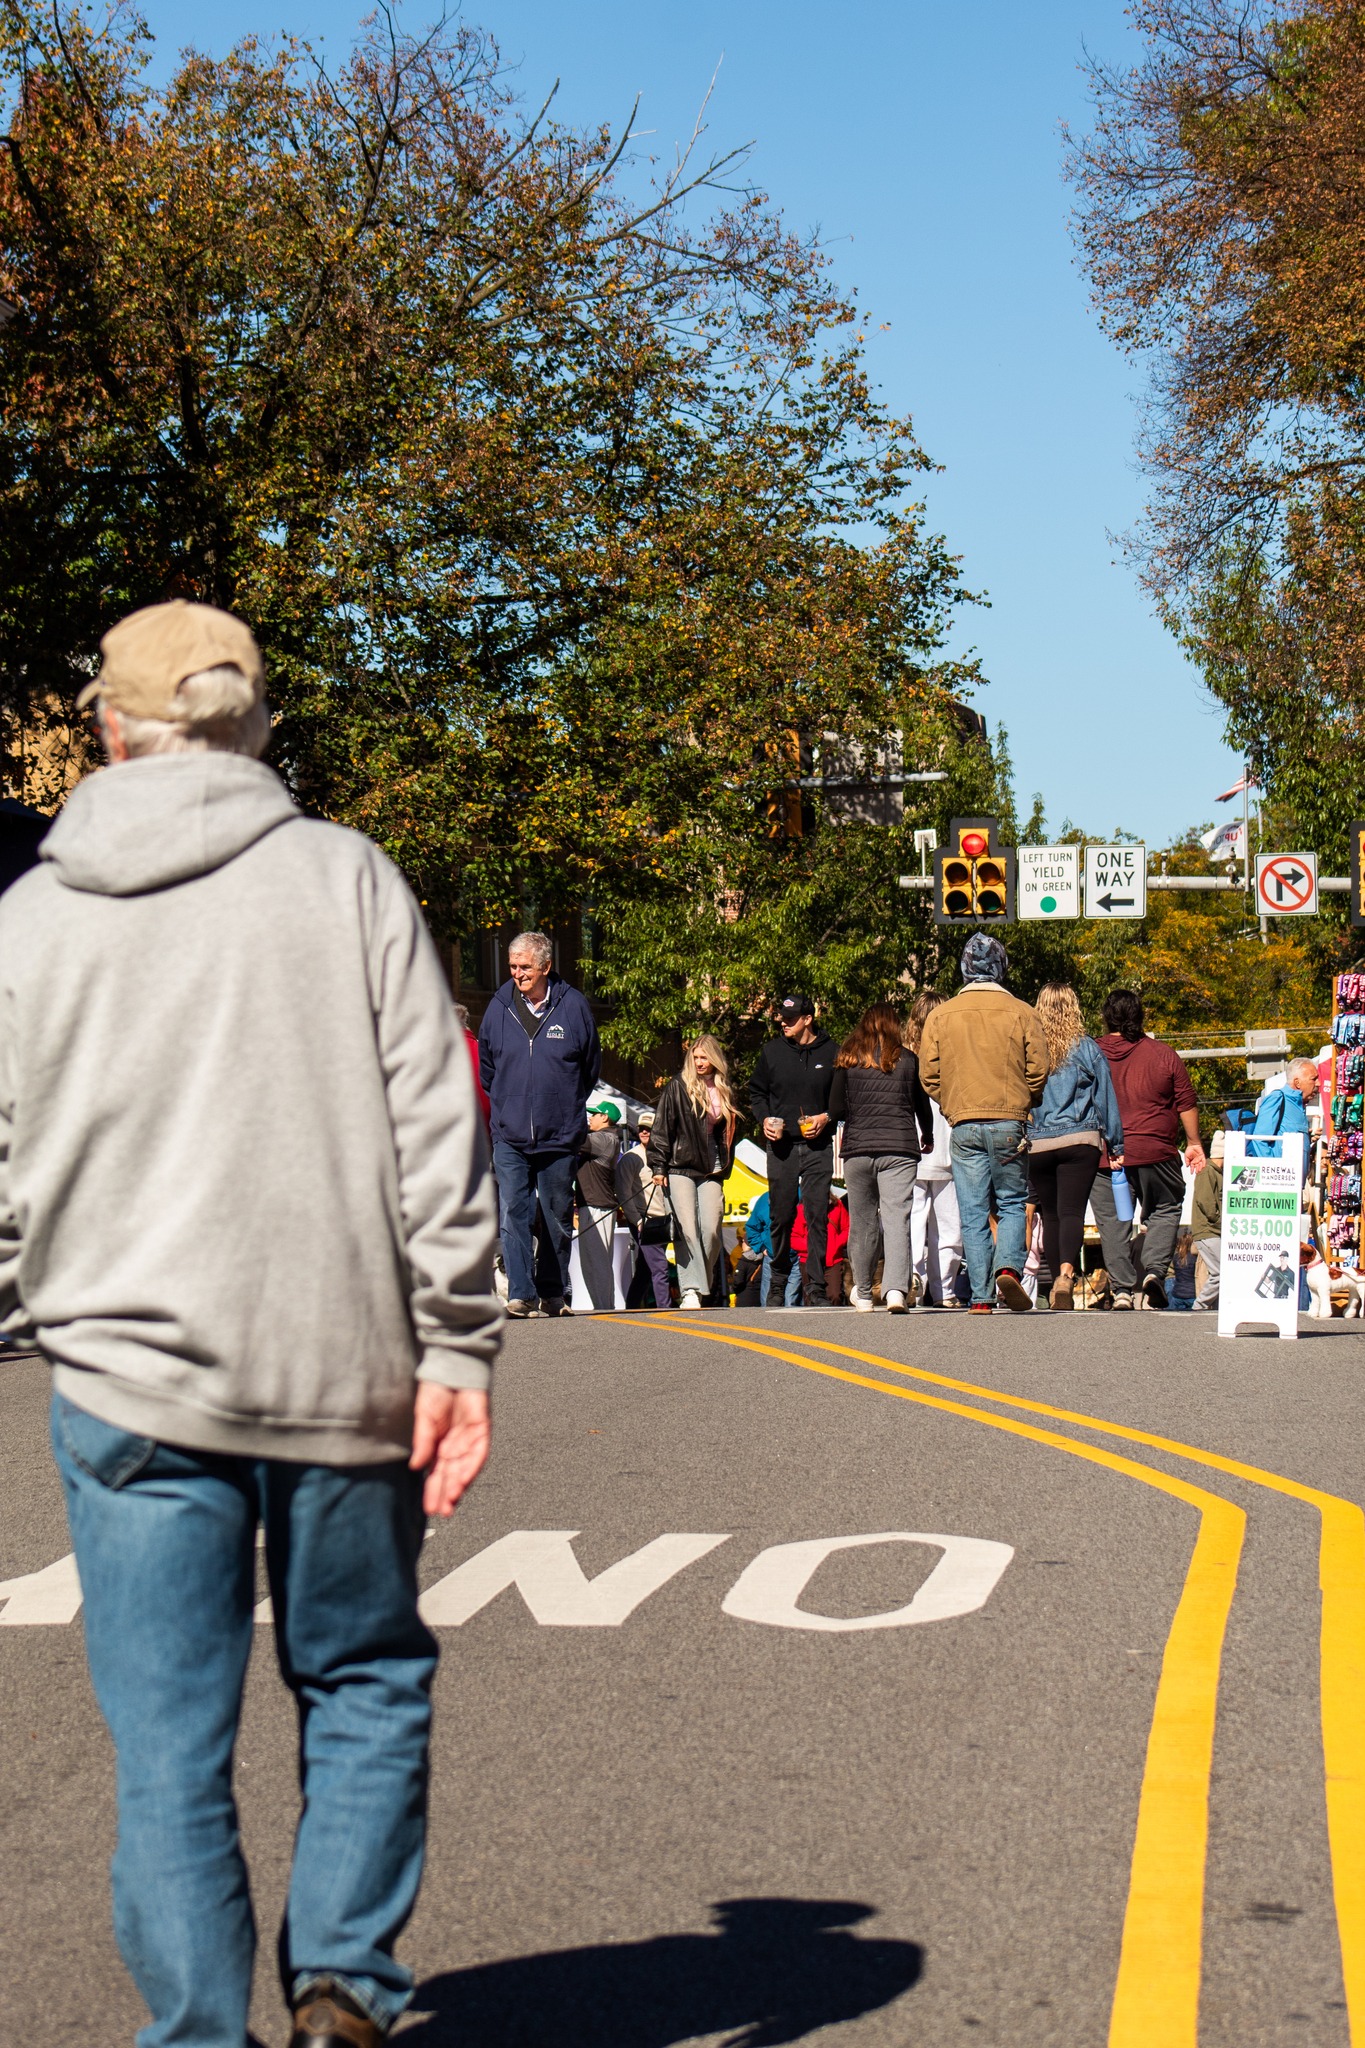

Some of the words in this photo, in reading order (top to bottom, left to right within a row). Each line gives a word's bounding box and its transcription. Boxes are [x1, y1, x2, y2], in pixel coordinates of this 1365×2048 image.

[1023, 853, 1044, 863] LEFT
[1048, 852, 1072, 862] TURN
[1097, 852, 1134, 867] ONE
[1032, 866, 1064, 878] YIELD
[1095, 871, 1135, 887] WAY
[1025, 882, 1037, 892] ON
[1042, 881, 1072, 891] GREEN
[1261, 1166, 1296, 1174] RENEWAL
[1229, 1197, 1259, 1208] ENTER
[1261, 1198, 1272, 1209] TO
[1273, 1198, 1295, 1210] WIN!
[1229, 1217, 1293, 1239] $35,000
[1228, 1242, 1255, 1251] WINDOW
[1256, 1243, 1262, 1251] &
[1263, 1243, 1281, 1251] DOOR
[1228, 1253, 1264, 1262] MAKEOVER
